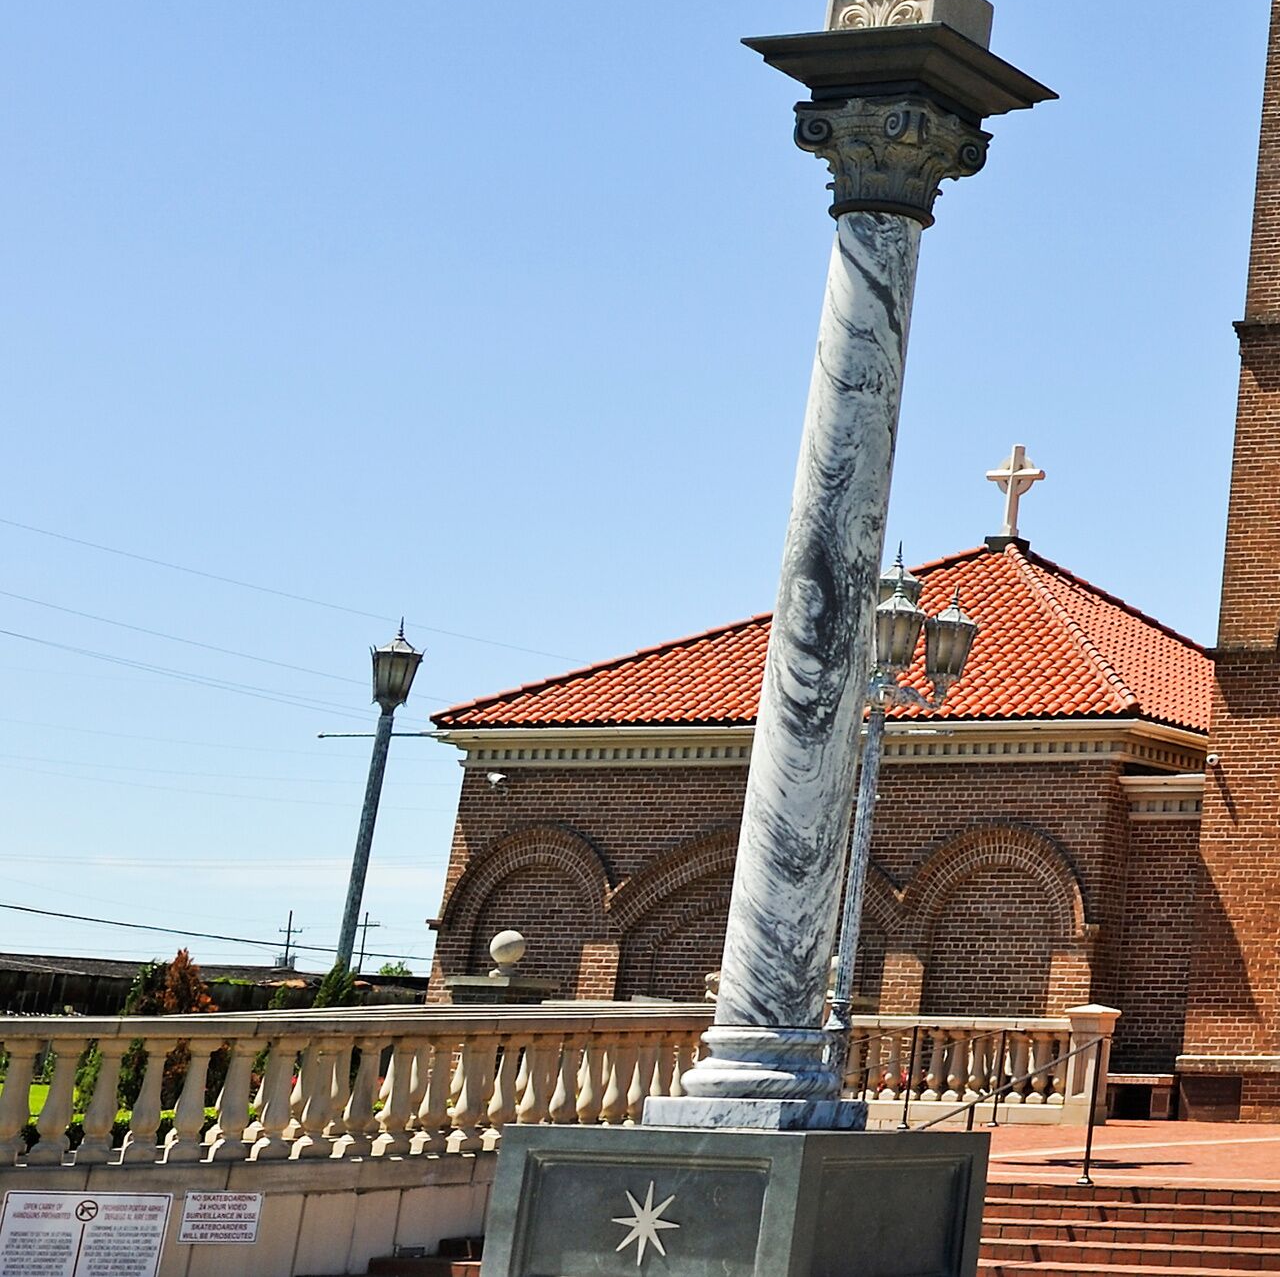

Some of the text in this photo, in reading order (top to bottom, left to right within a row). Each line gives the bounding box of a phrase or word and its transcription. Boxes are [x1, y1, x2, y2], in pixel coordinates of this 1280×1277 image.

[192, 1194, 257, 1202] NO SKATEBOARDING
[23, 1202, 37, 1210] OPEN
[38, 1202, 56, 1210] CARRY
[198, 1203, 248, 1211] 24 HOUR VIDEO
[191, 1223, 248, 1231] SKATEBOARDERS
